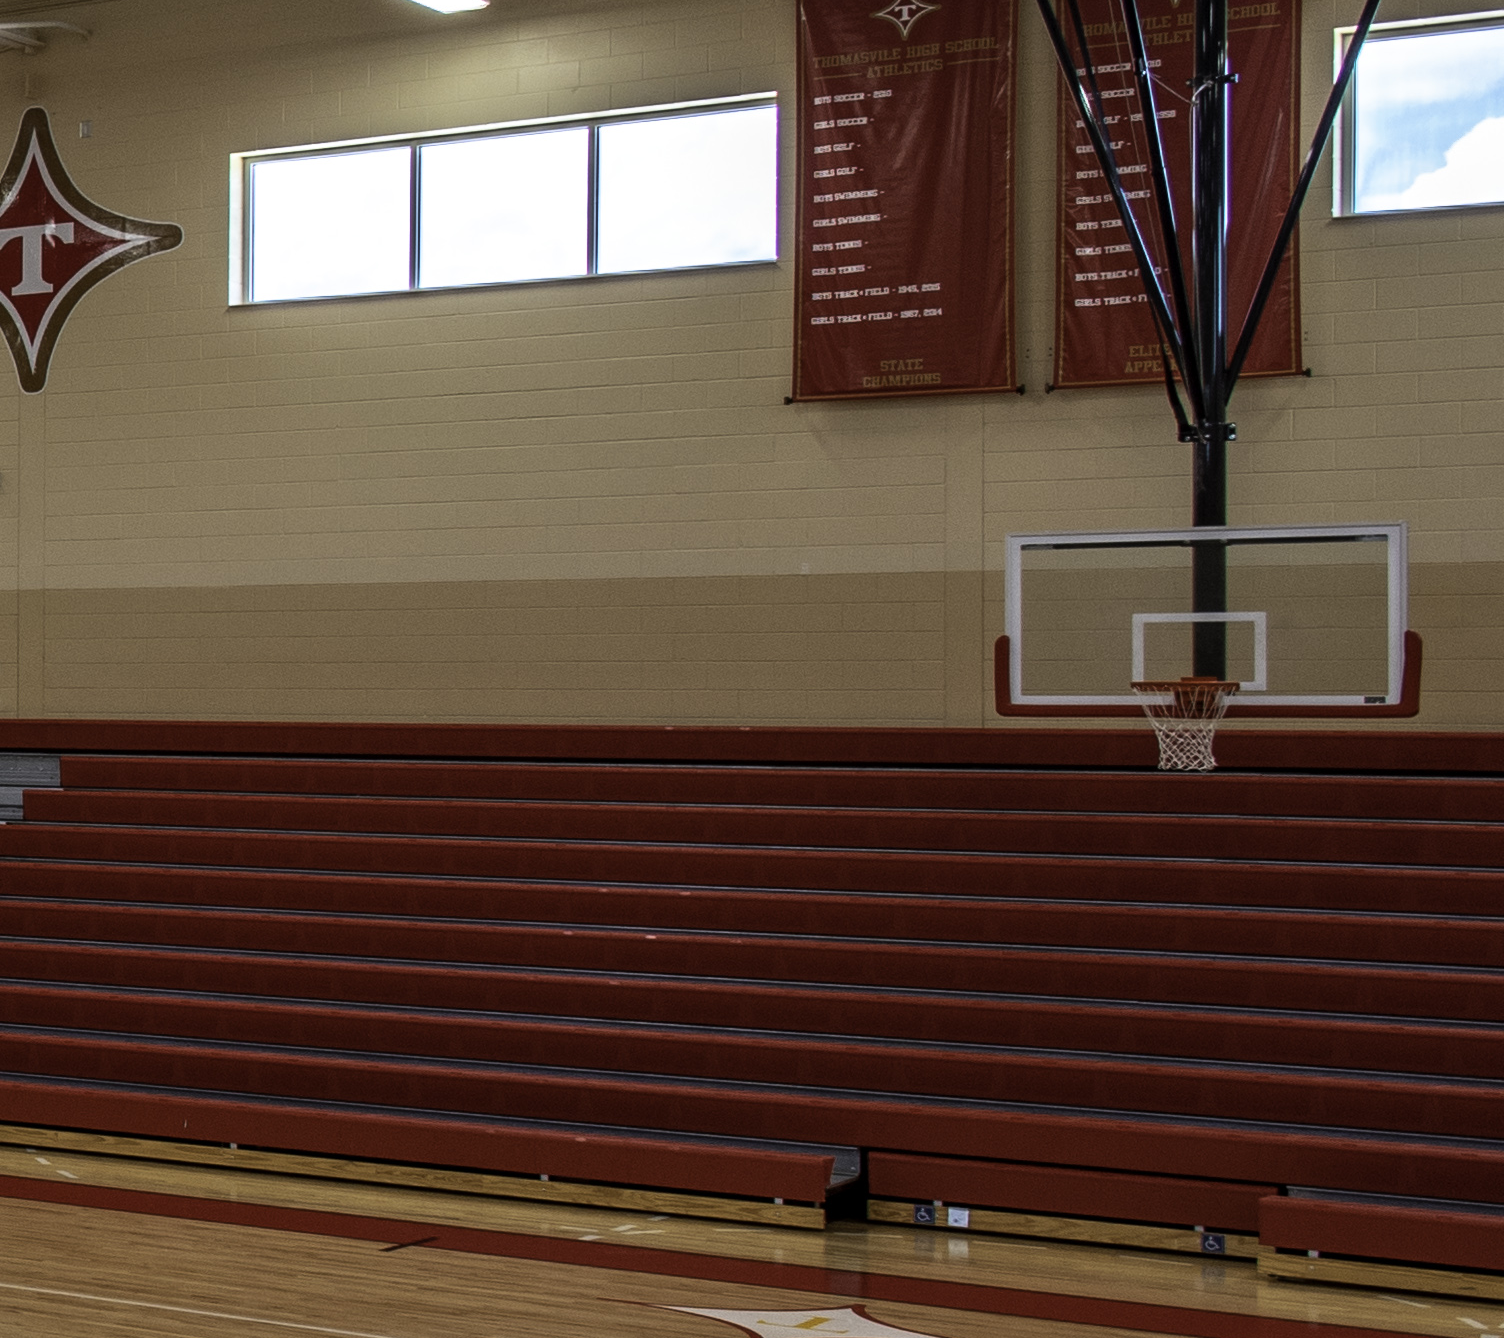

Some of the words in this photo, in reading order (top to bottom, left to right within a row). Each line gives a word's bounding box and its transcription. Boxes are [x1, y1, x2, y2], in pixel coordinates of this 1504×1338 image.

[907, 44, 940, 57] HIGH
[945, 37, 999, 54] SCHOOL
[866, 60, 943, 79] ATHLETICS
[880, 359, 923, 371] STATE
[863, 374, 941, 388] CHAMPIONS
